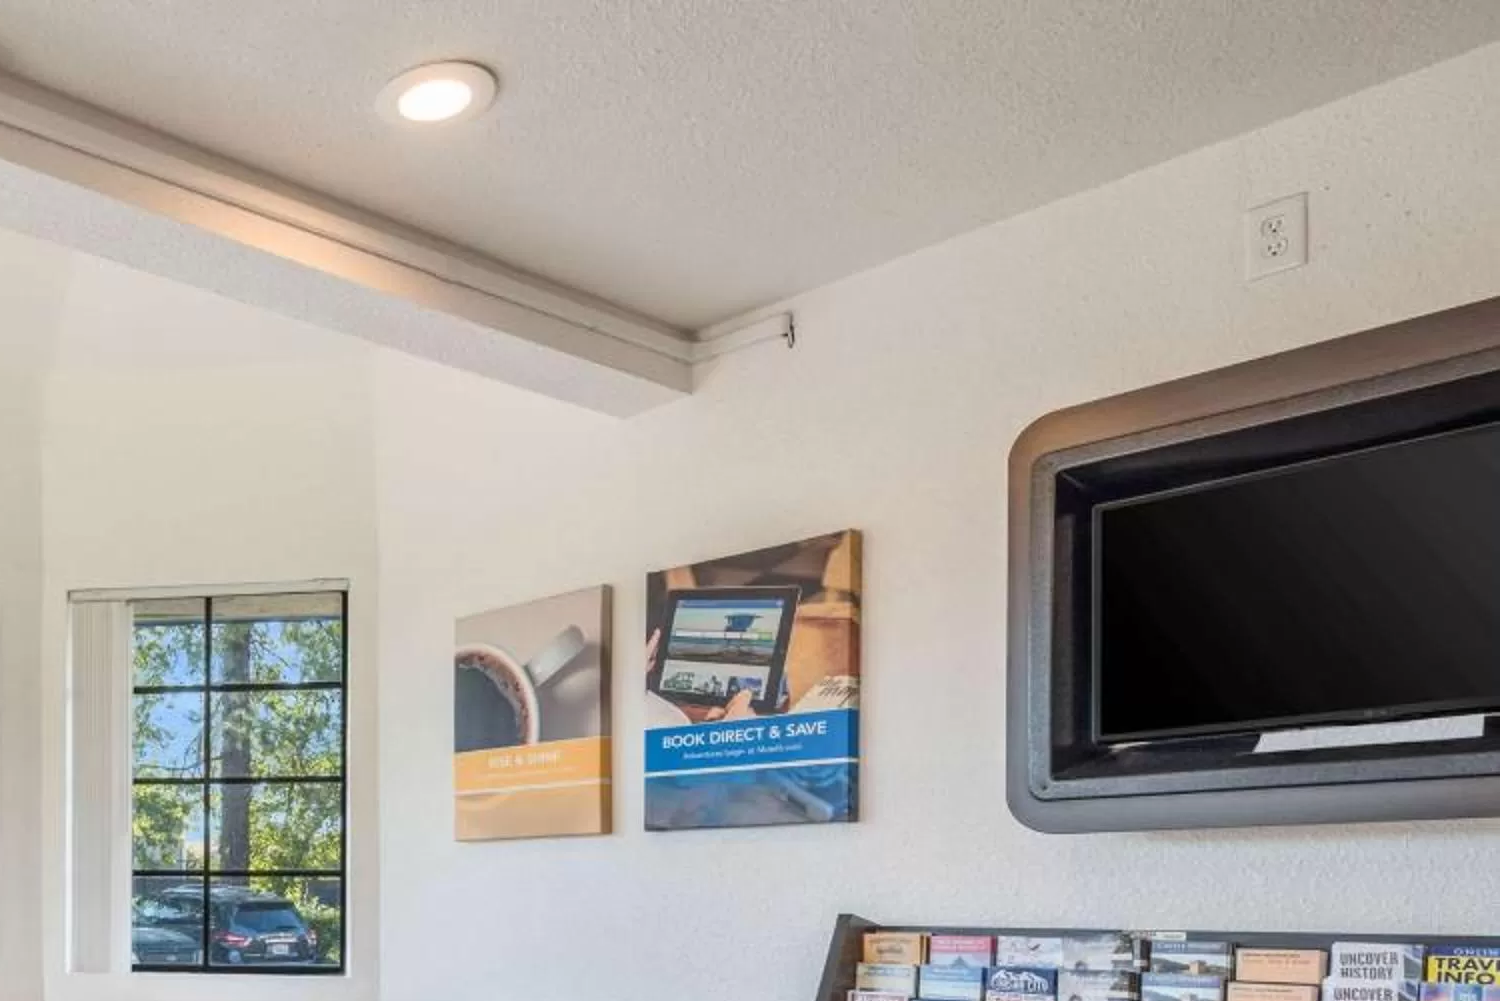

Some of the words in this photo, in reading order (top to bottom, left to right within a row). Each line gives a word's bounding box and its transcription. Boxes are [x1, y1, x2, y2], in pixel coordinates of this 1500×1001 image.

[663, 733, 706, 749] BOOK
[709, 726, 764, 744] DIRECT
[769, 725, 780, 739] &
[786, 719, 828, 736] SAVE
[1339, 951, 1399, 966] UNCOVER
[1340, 967, 1394, 980] HISTORY
[1437, 971, 1496, 985] INFO
[1333, 987, 1393, 1001] UNCOVER
